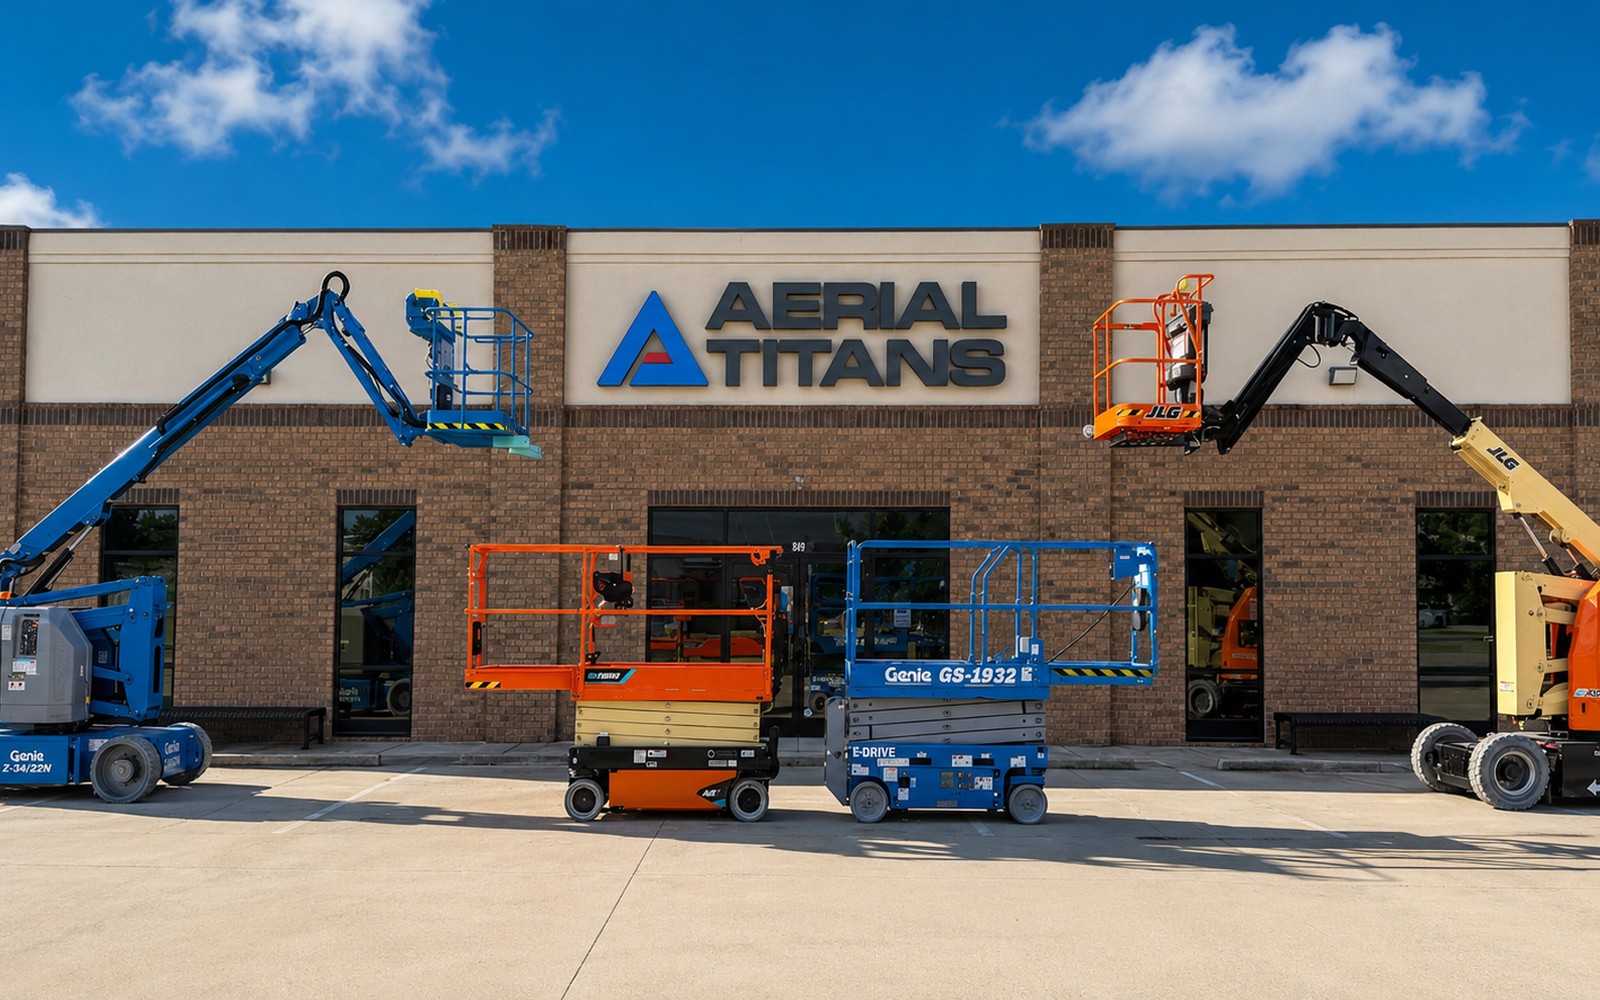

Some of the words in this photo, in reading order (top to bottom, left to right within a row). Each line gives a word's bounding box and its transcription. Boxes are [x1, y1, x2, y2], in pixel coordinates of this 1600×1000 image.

[704, 281, 1007, 330] AERIAL
[706, 339, 1006, 387] TITANS
[1144, 405, 1182, 419] JLG
[1486, 446, 1520, 471] JLG
[884, 667, 932, 683] Genie
[939, 667, 1017, 684] GS-1932
[10, 749, 44, 762] Genie
[852, 746, 896, 758] E-DRIVE
[2, 763, 52, 773] Z-34/22N
